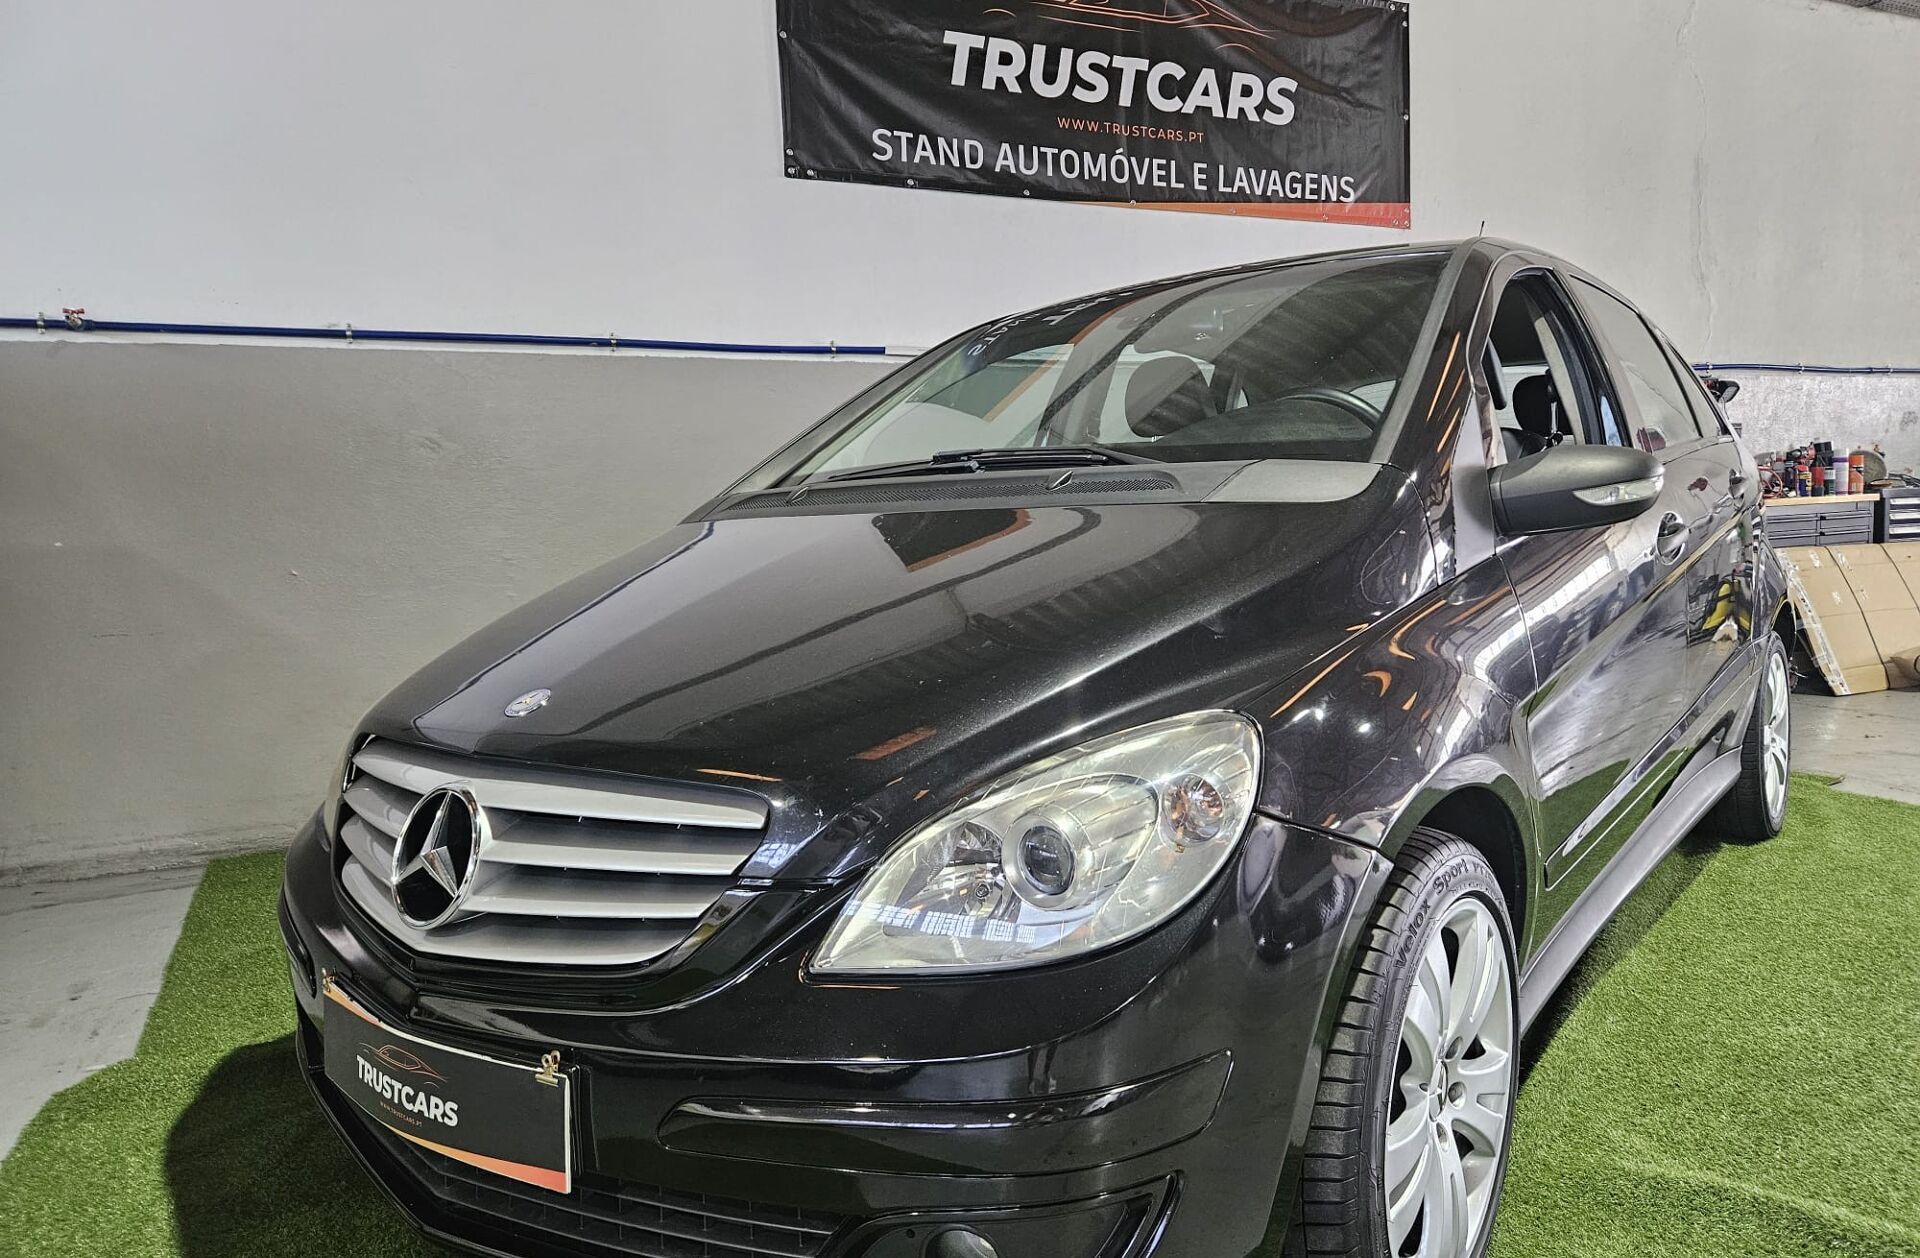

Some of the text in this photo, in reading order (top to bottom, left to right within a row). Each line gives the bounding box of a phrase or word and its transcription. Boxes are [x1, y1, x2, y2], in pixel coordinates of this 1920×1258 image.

[943, 30, 1298, 125] TRUSTCARS
[872, 128, 1355, 203] STAND AUTOMÓVEL E LAVAGENS
[1057, 116, 1204, 143] WWW.TRUSTCARS.PT
[1393, 858, 1469, 968] Velox Sport
[356, 1054, 459, 1127] TRUSTCARS
